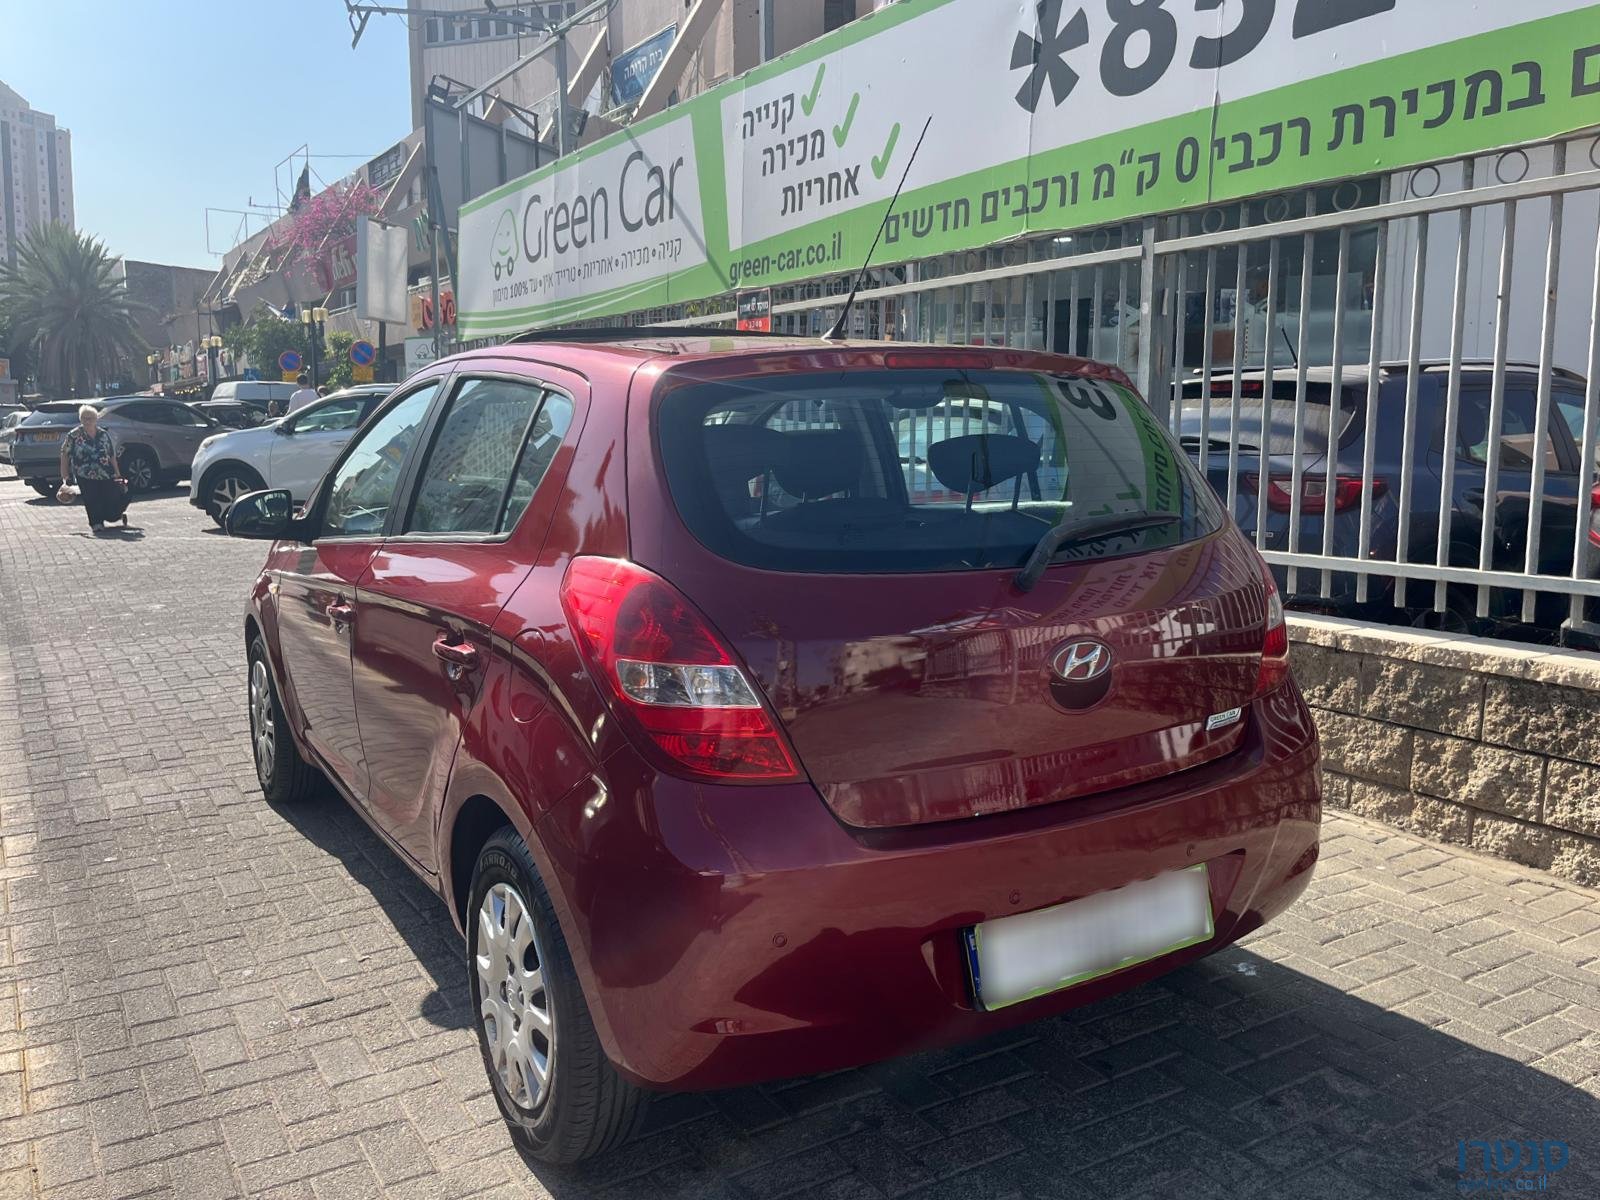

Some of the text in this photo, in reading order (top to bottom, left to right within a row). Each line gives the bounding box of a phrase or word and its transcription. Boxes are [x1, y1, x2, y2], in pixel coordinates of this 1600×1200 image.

[742, 93, 795, 139] קנייה
[1326, 60, 1546, 150] במכירת
[762, 128, 825, 176] מכירה
[1175, 136, 1199, 183] 0
[1213, 116, 1312, 173] רכבי
[522, 189, 608, 263] Green
[619, 150, 684, 233] Car
[781, 164, 861, 216] אחריות
[980, 168, 1079, 225] ורכבים
[885, 197, 970, 244] חדשים
[555, 266, 576, 284] טרייד
[582, 257, 614, 279] אחריות
[621, 246, 650, 270] מכירה
[658, 238, 682, 267] קניה
[729, 232, 842, 287] green-car.co.il
[510, 283, 528, 299] 100%
[543, 273, 555, 294] אין
